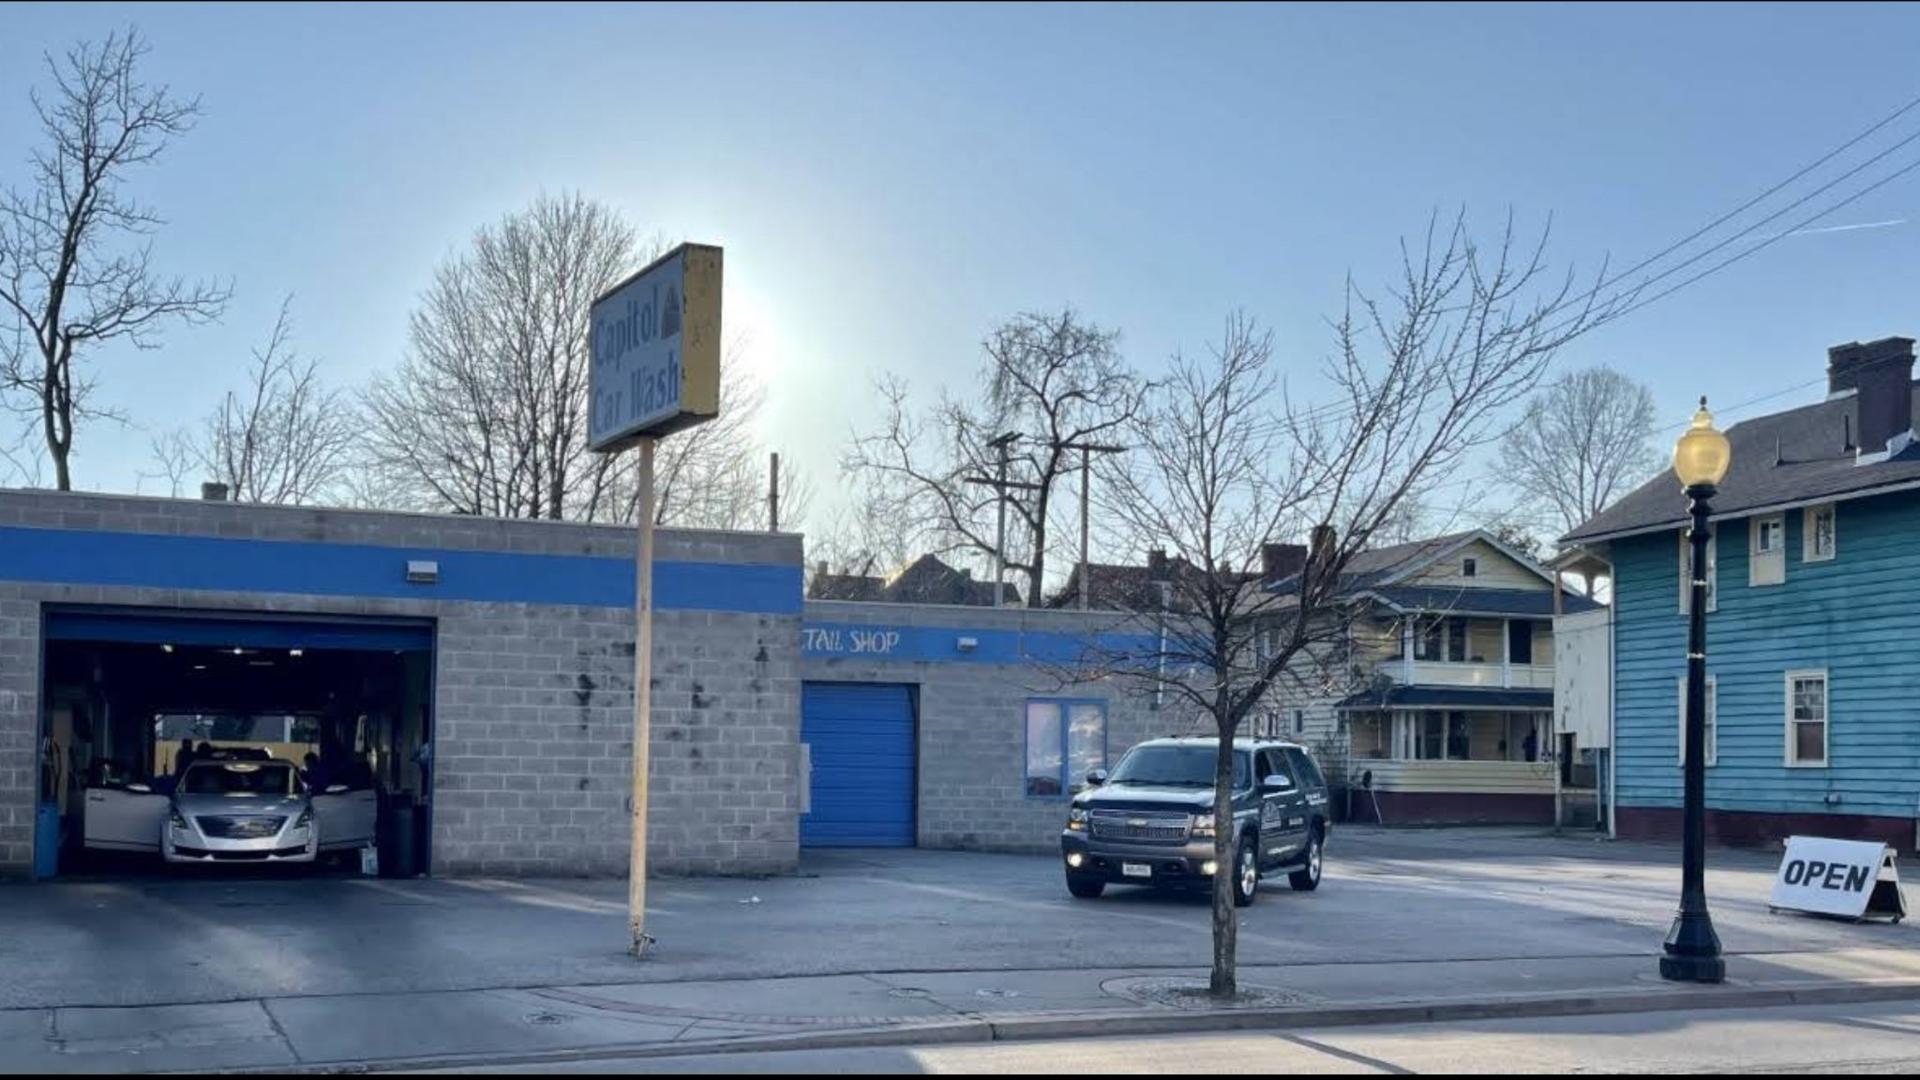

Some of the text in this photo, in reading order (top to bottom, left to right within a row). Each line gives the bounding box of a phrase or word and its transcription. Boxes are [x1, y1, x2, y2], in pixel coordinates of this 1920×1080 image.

[594, 284, 658, 372] Capitol
[592, 351, 679, 434] Car Wash
[801, 628, 899, 653] TAIL SHOP
[1784, 859, 1870, 893] OPEN
